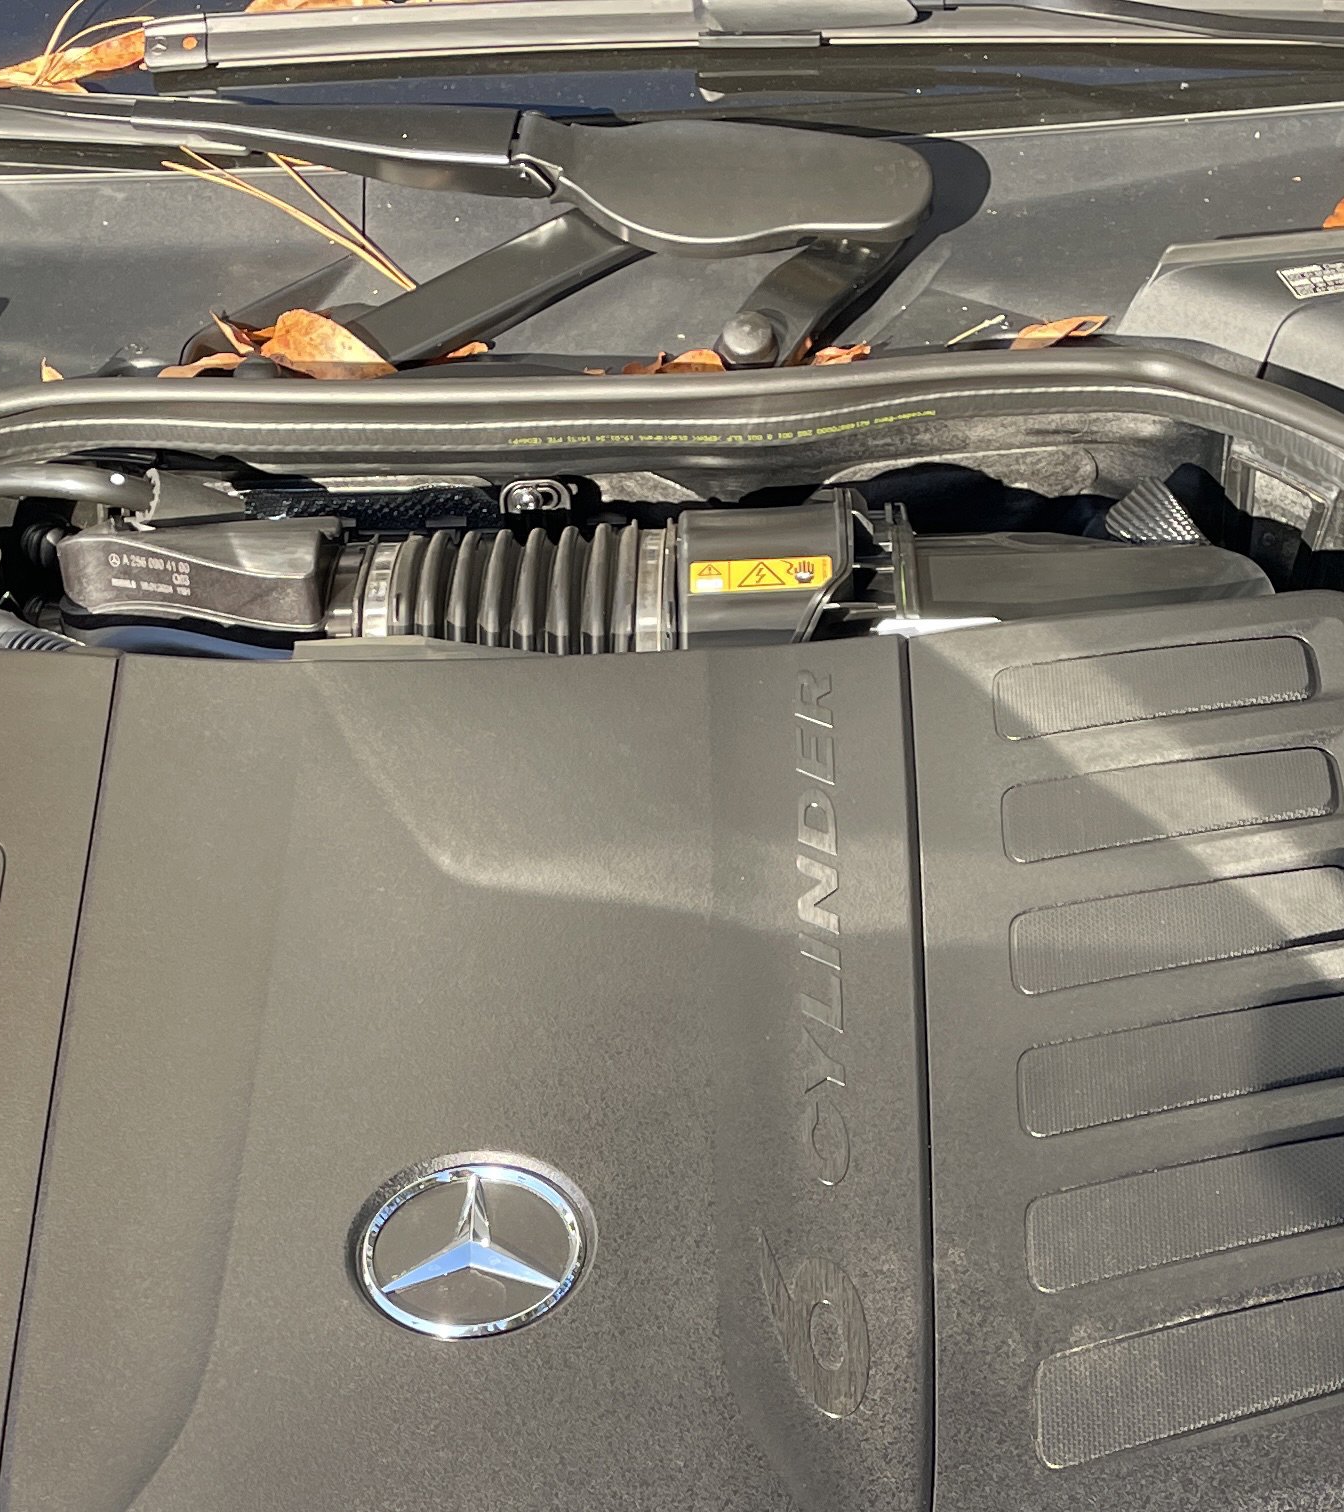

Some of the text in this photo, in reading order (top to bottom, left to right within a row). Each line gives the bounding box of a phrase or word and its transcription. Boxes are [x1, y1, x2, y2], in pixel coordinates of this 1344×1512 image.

[122, 554, 130, 566] A
[757, 667, 871, 1419] 6 CYLINDER
